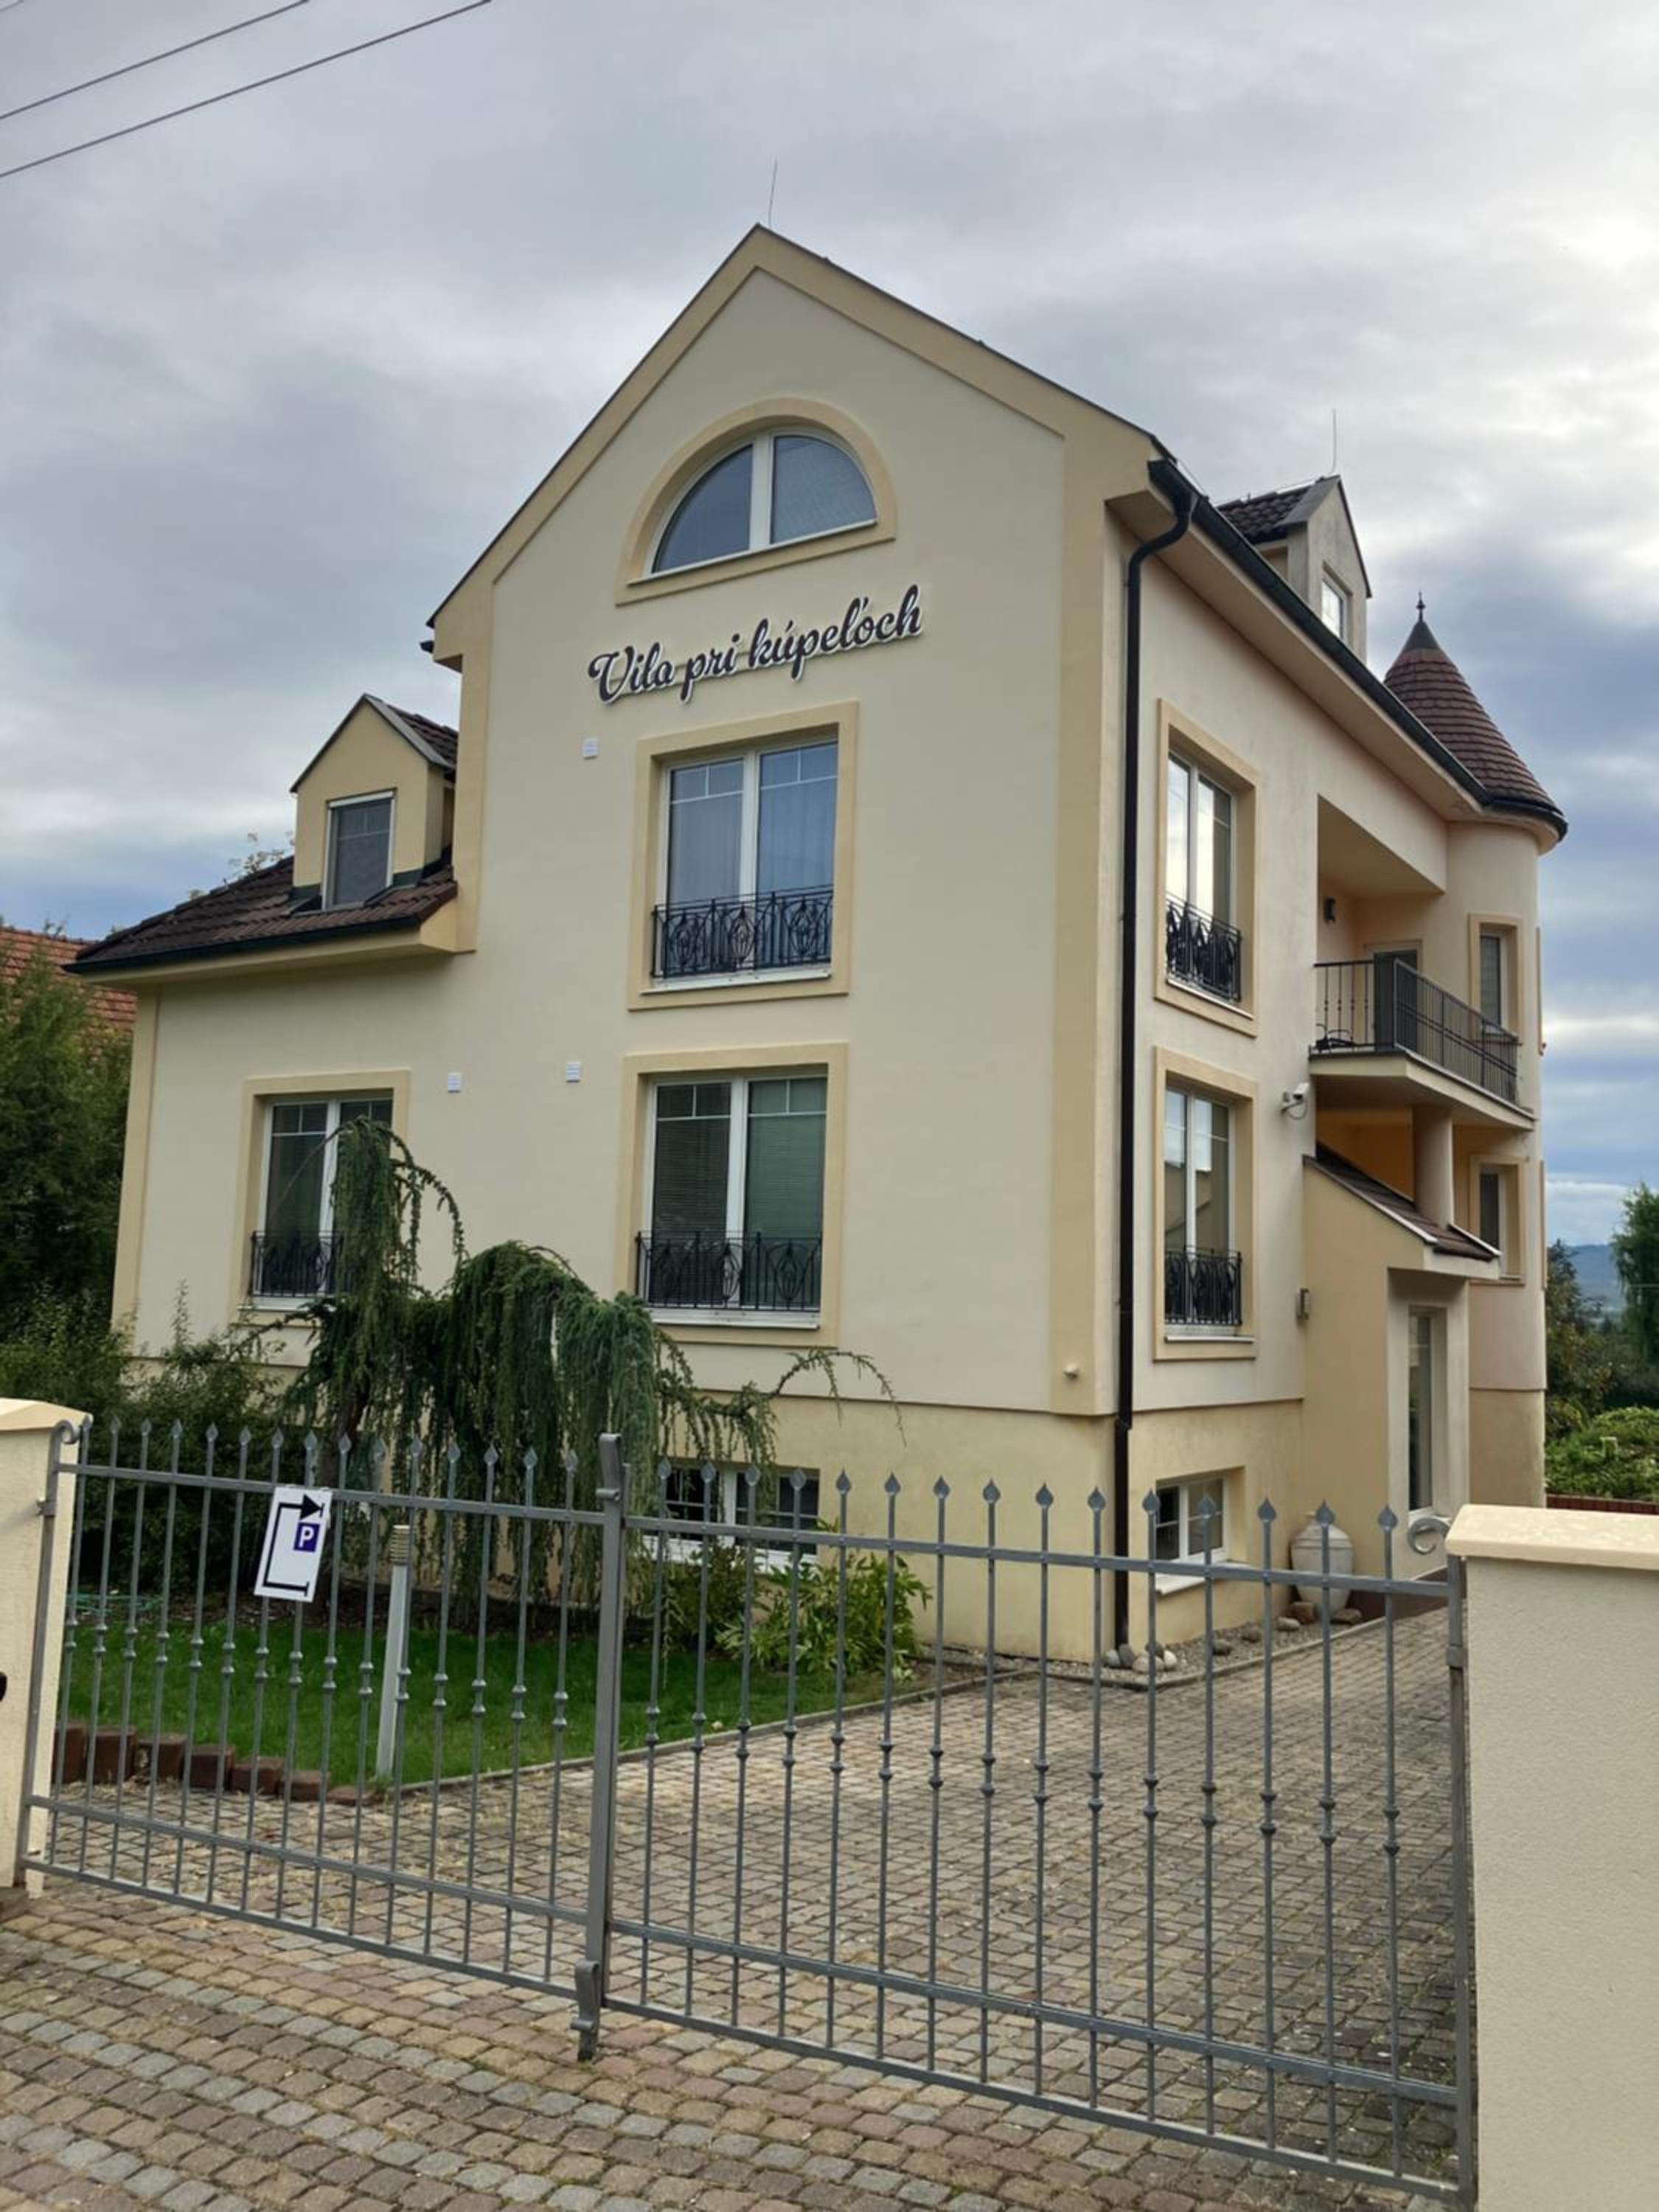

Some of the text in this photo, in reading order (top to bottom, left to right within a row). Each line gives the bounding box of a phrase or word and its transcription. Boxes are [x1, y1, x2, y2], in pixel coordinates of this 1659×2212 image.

[588, 641, 674, 702] Vila
[680, 633, 741, 701] pri
[298, 1526, 315, 1548] P
